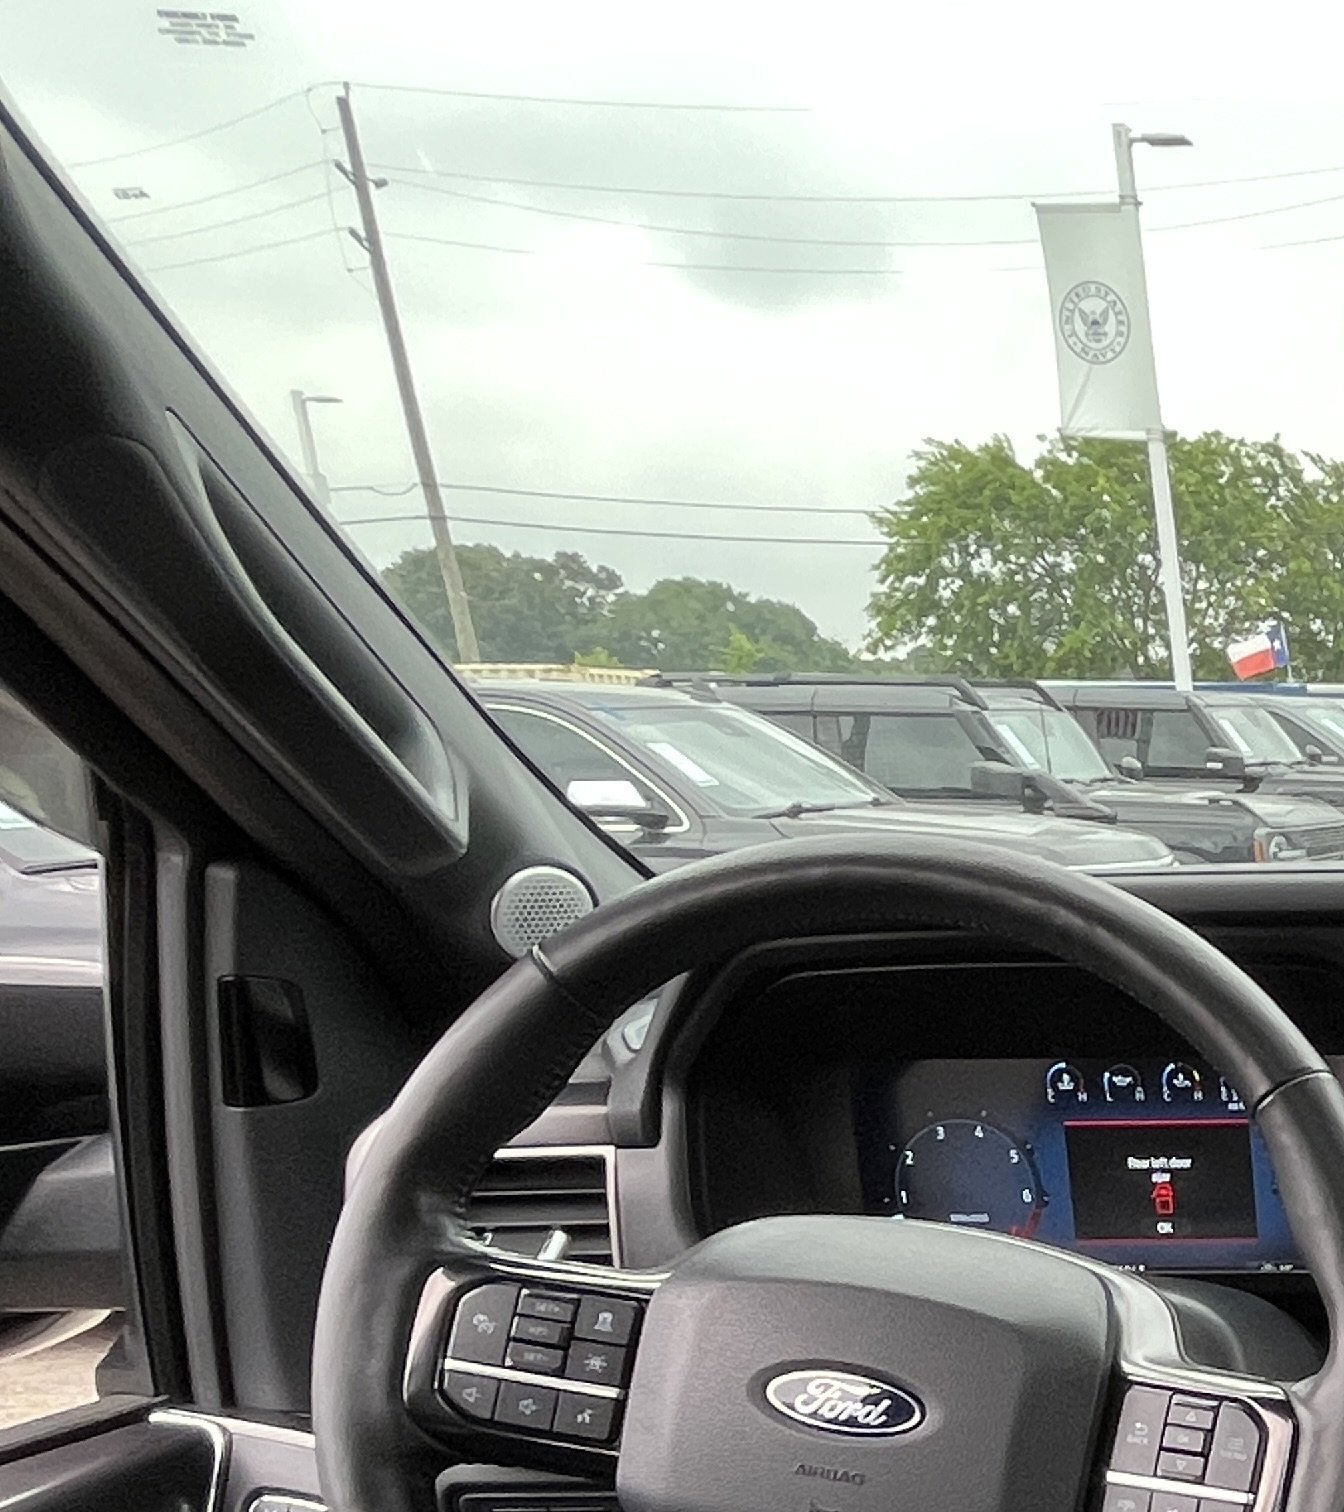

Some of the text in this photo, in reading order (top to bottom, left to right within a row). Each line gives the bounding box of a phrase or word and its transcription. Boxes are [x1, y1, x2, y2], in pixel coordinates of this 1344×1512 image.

[1080, 346, 1118, 361] NAVY
[936, 1126, 946, 1140] 3
[973, 1125, 984, 1138] 4
[904, 1150, 915, 1165] 2
[1009, 1149, 1020, 1164] 5
[900, 1190, 908, 1204] 1
[1022, 1188, 1033, 1203] 6
[794, 1377, 892, 1427] Ford
[794, 1463, 866, 1486] AIRBAG
